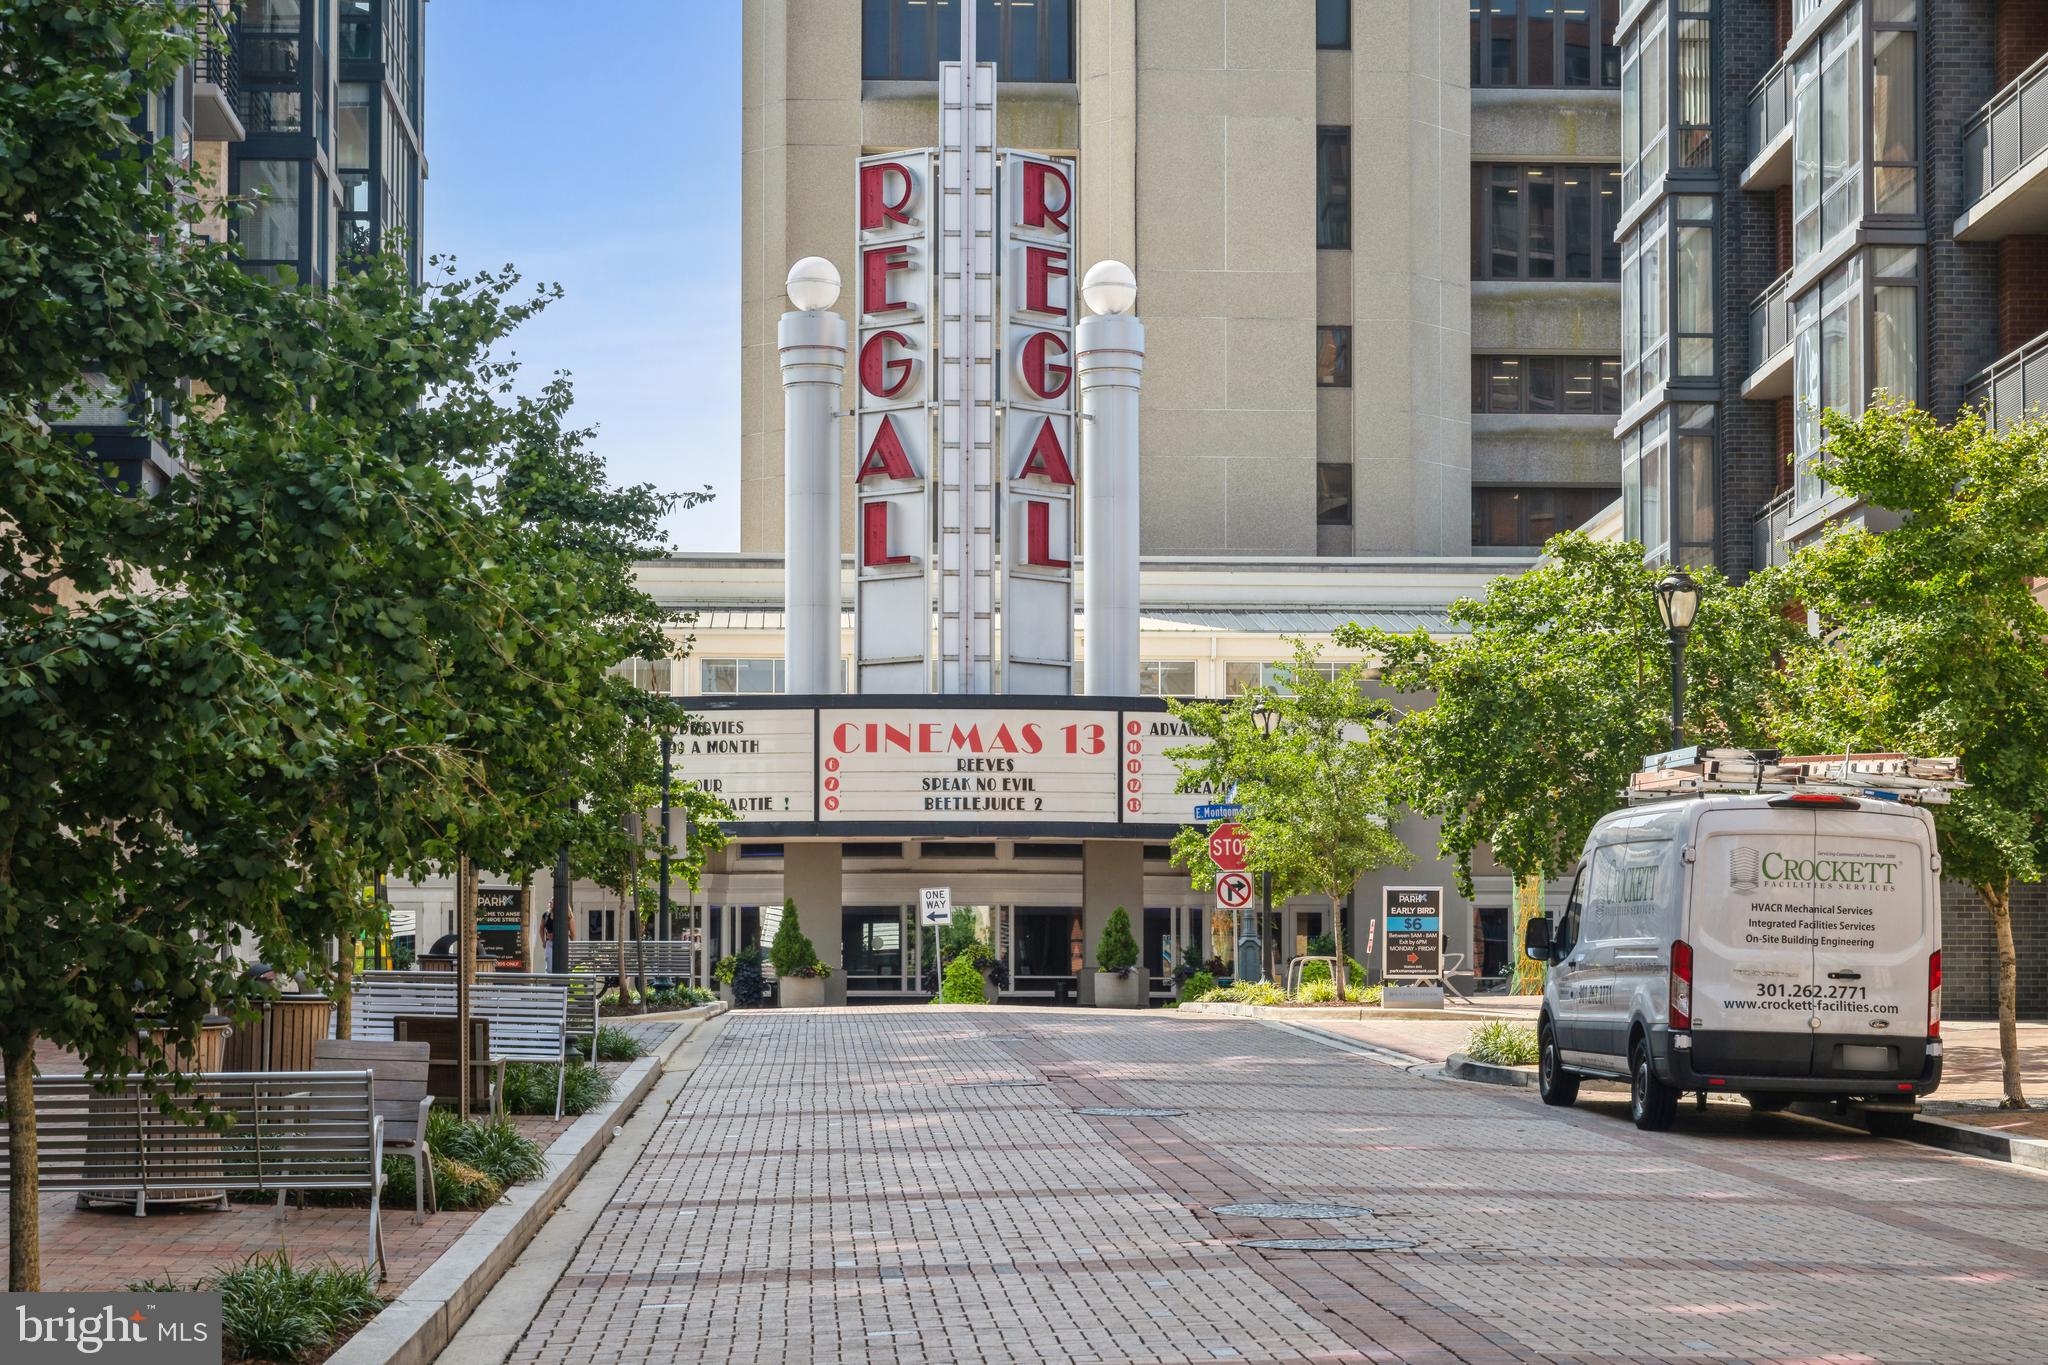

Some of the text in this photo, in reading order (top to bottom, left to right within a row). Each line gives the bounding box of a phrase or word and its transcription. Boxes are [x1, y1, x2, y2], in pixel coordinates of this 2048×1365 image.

[856, 162, 918, 567] REGAL
[1019, 161, 1075, 568] REGAL
[833, 722, 1106, 754] CINEMAS 13
[691, 741, 701, 754] A
[707, 740, 760, 753] MONTH
[957, 758, 1014, 772] REEVES
[922, 777, 1036, 791] SPEAK NO EVIL
[924, 797, 1043, 811] BEETLEJUICE 2
[1762, 852, 1898, 884] CROCKETT
[1764, 881, 1896, 892] FACILITIES SERVICES
[926, 890, 945, 899] ONE
[926, 900, 946, 909] WAY
[1391, 907, 1435, 915] EARLY BIRD
[1751, 903, 1873, 915] HVACR Mechanical Services
[1404, 917, 1422, 930] $6
[1749, 918, 1876, 931] Integrated Facilities Services
[1745, 934, 1875, 949] On-Site Building Engineering
[1757, 983, 1867, 999] 301.262.2771
[1723, 999, 1899, 1014] www.crockett-facilities.com
